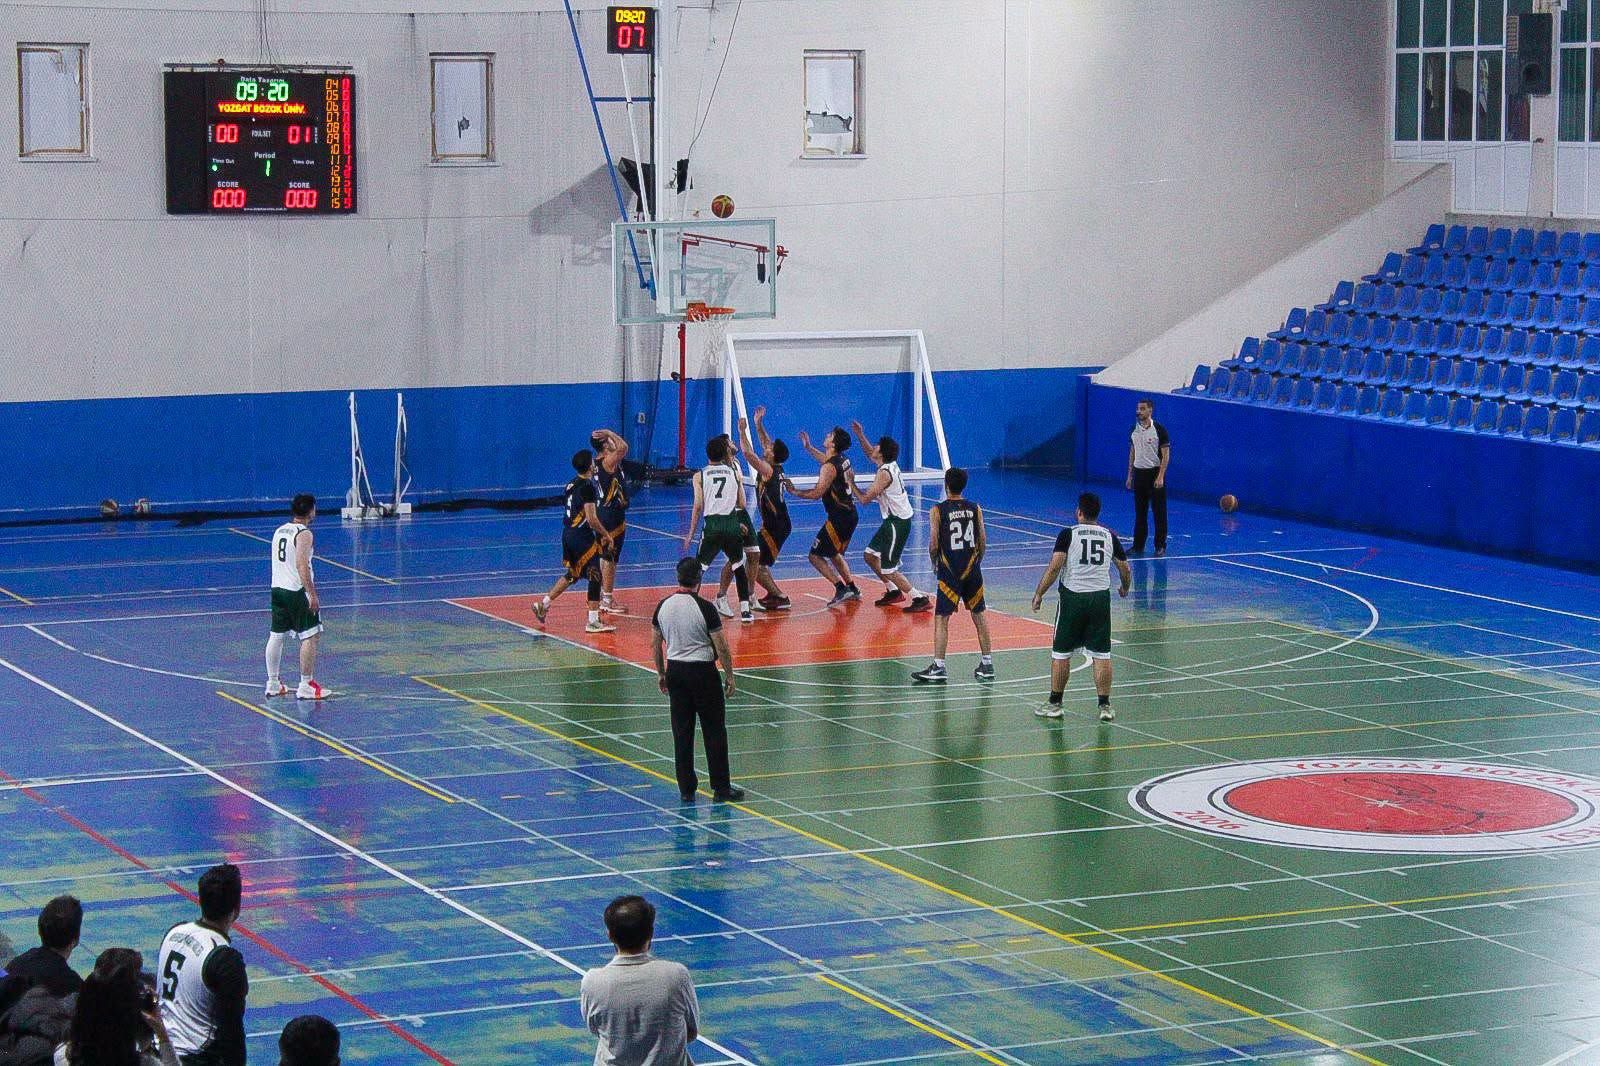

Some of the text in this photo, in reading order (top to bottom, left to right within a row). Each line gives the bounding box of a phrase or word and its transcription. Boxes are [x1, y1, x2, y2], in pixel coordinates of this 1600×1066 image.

[617, 25, 645, 48] 07
[326, 78, 339, 90] 04
[326, 89, 339, 101] 05
[218, 103, 252, 113] YOZGAT
[253, 103, 282, 113] BOZOK
[326, 100, 339, 112] 06
[326, 111, 339, 123] 07
[215, 124, 239, 143] 00
[326, 122, 340, 133] 08
[287, 125, 311, 144] 01
[326, 133, 340, 144] 09
[330, 143, 340, 155] 10
[330, 154, 340, 165] 11
[265, 160, 271, 177] 1
[330, 165, 341, 177] 12
[331, 176, 341, 187] 13
[212, 188, 246, 208] 000
[285, 189, 318, 208] 000
[331, 187, 341, 198] 14
[331, 198, 341, 209] 15
[712, 476, 727, 499] 7
[949, 519, 976, 551] 24
[278, 537, 288, 562] 8
[1078, 538, 1105, 566] 15
[1173, 809, 1249, 831] 2006
[162, 950, 186, 1001] 5
